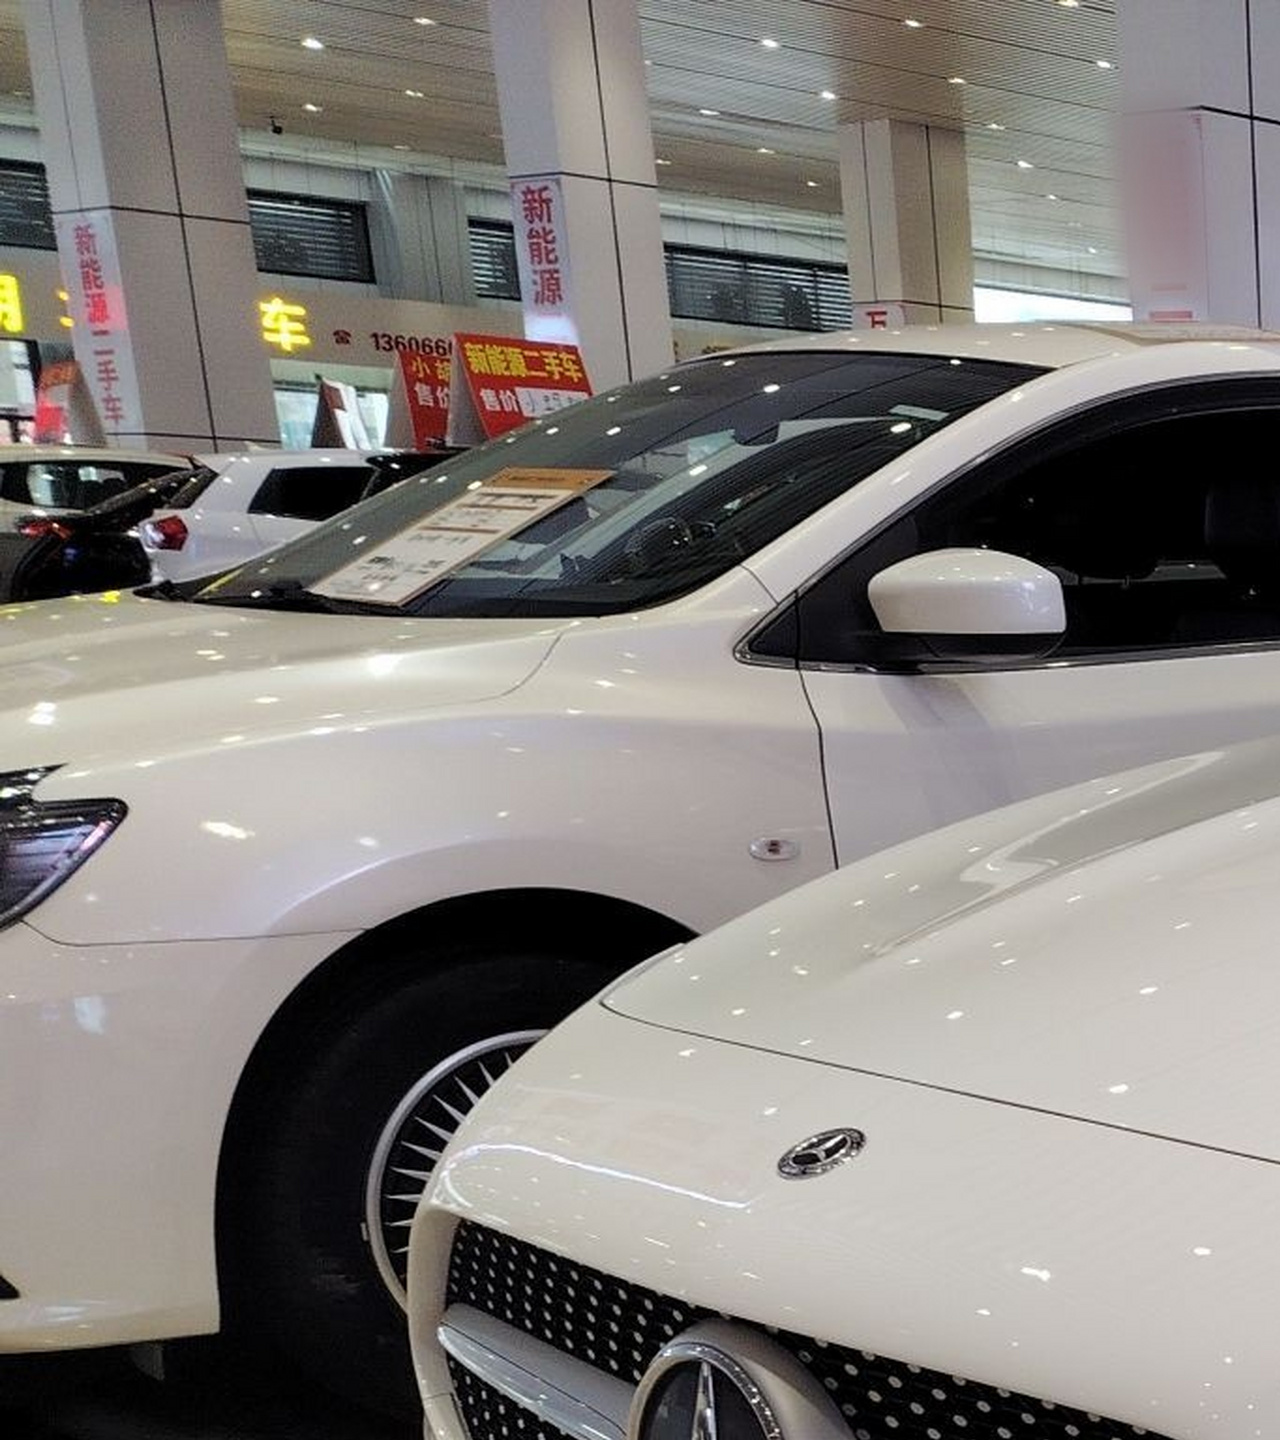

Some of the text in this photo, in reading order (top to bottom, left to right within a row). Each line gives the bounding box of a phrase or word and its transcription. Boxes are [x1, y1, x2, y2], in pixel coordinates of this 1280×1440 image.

[521, 185, 563, 305] 新能源
[258, 297, 311, 352] 车
[370, 333, 453, 357] 136066
[464, 342, 583, 382] 新能源二手车
[480, 387, 519, 412] 售价
